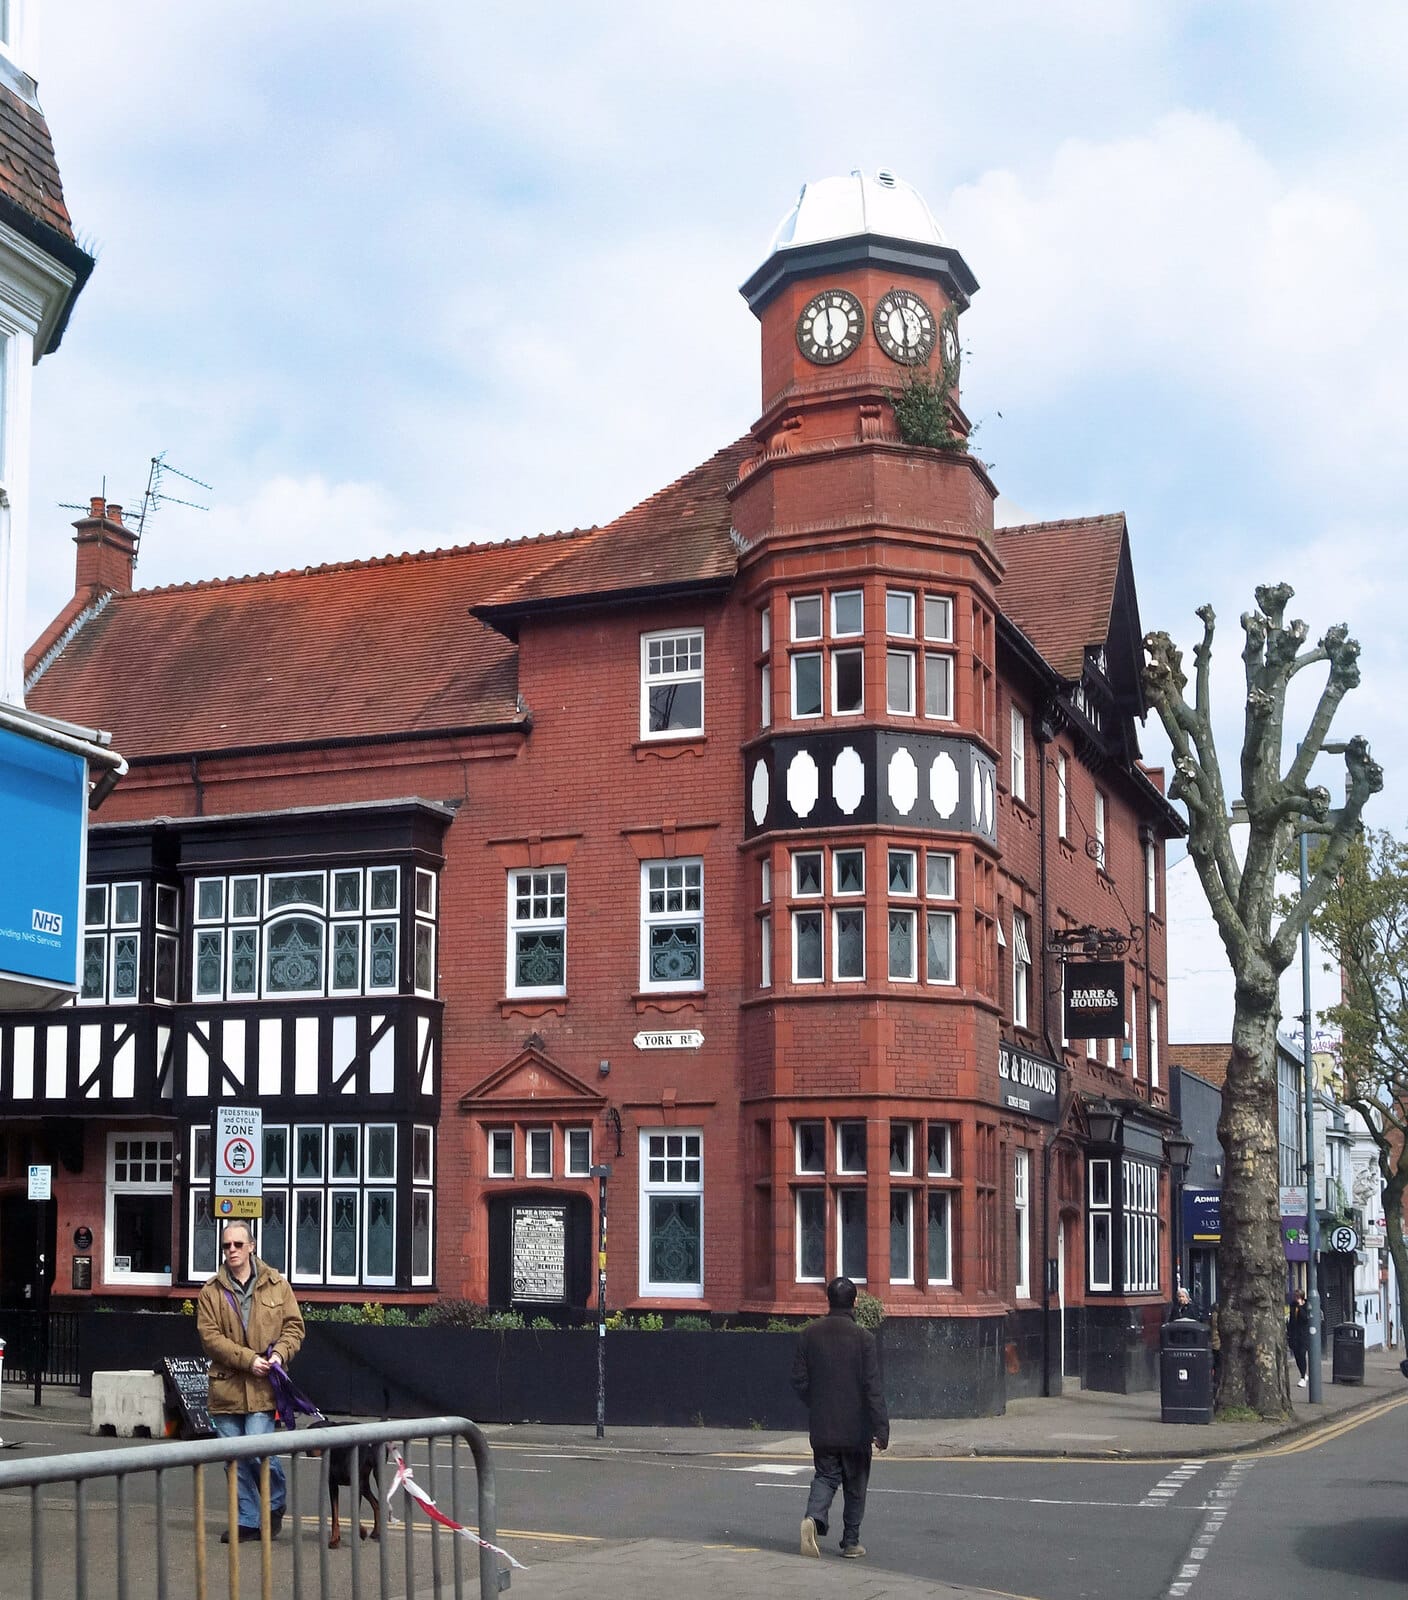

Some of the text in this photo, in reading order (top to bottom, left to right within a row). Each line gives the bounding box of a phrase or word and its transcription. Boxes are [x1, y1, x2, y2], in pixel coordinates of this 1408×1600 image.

[33, 911, 61, 932] NHS
[36, 935, 62, 948] Services
[1072, 988, 1116, 999] HARE &
[1070, 997, 1119, 1008] HOUNDS
[644, 1035, 673, 1046] YORK
[1020, 1057, 1057, 1096] HOUNDS
[220, 1109, 260, 1117] PEDESTRIAN
[235, 1116, 256, 1124] CYCLE
[225, 1125, 254, 1136] ZONE
[223, 1179, 244, 1187] Except
[240, 1206, 254, 1214] time
